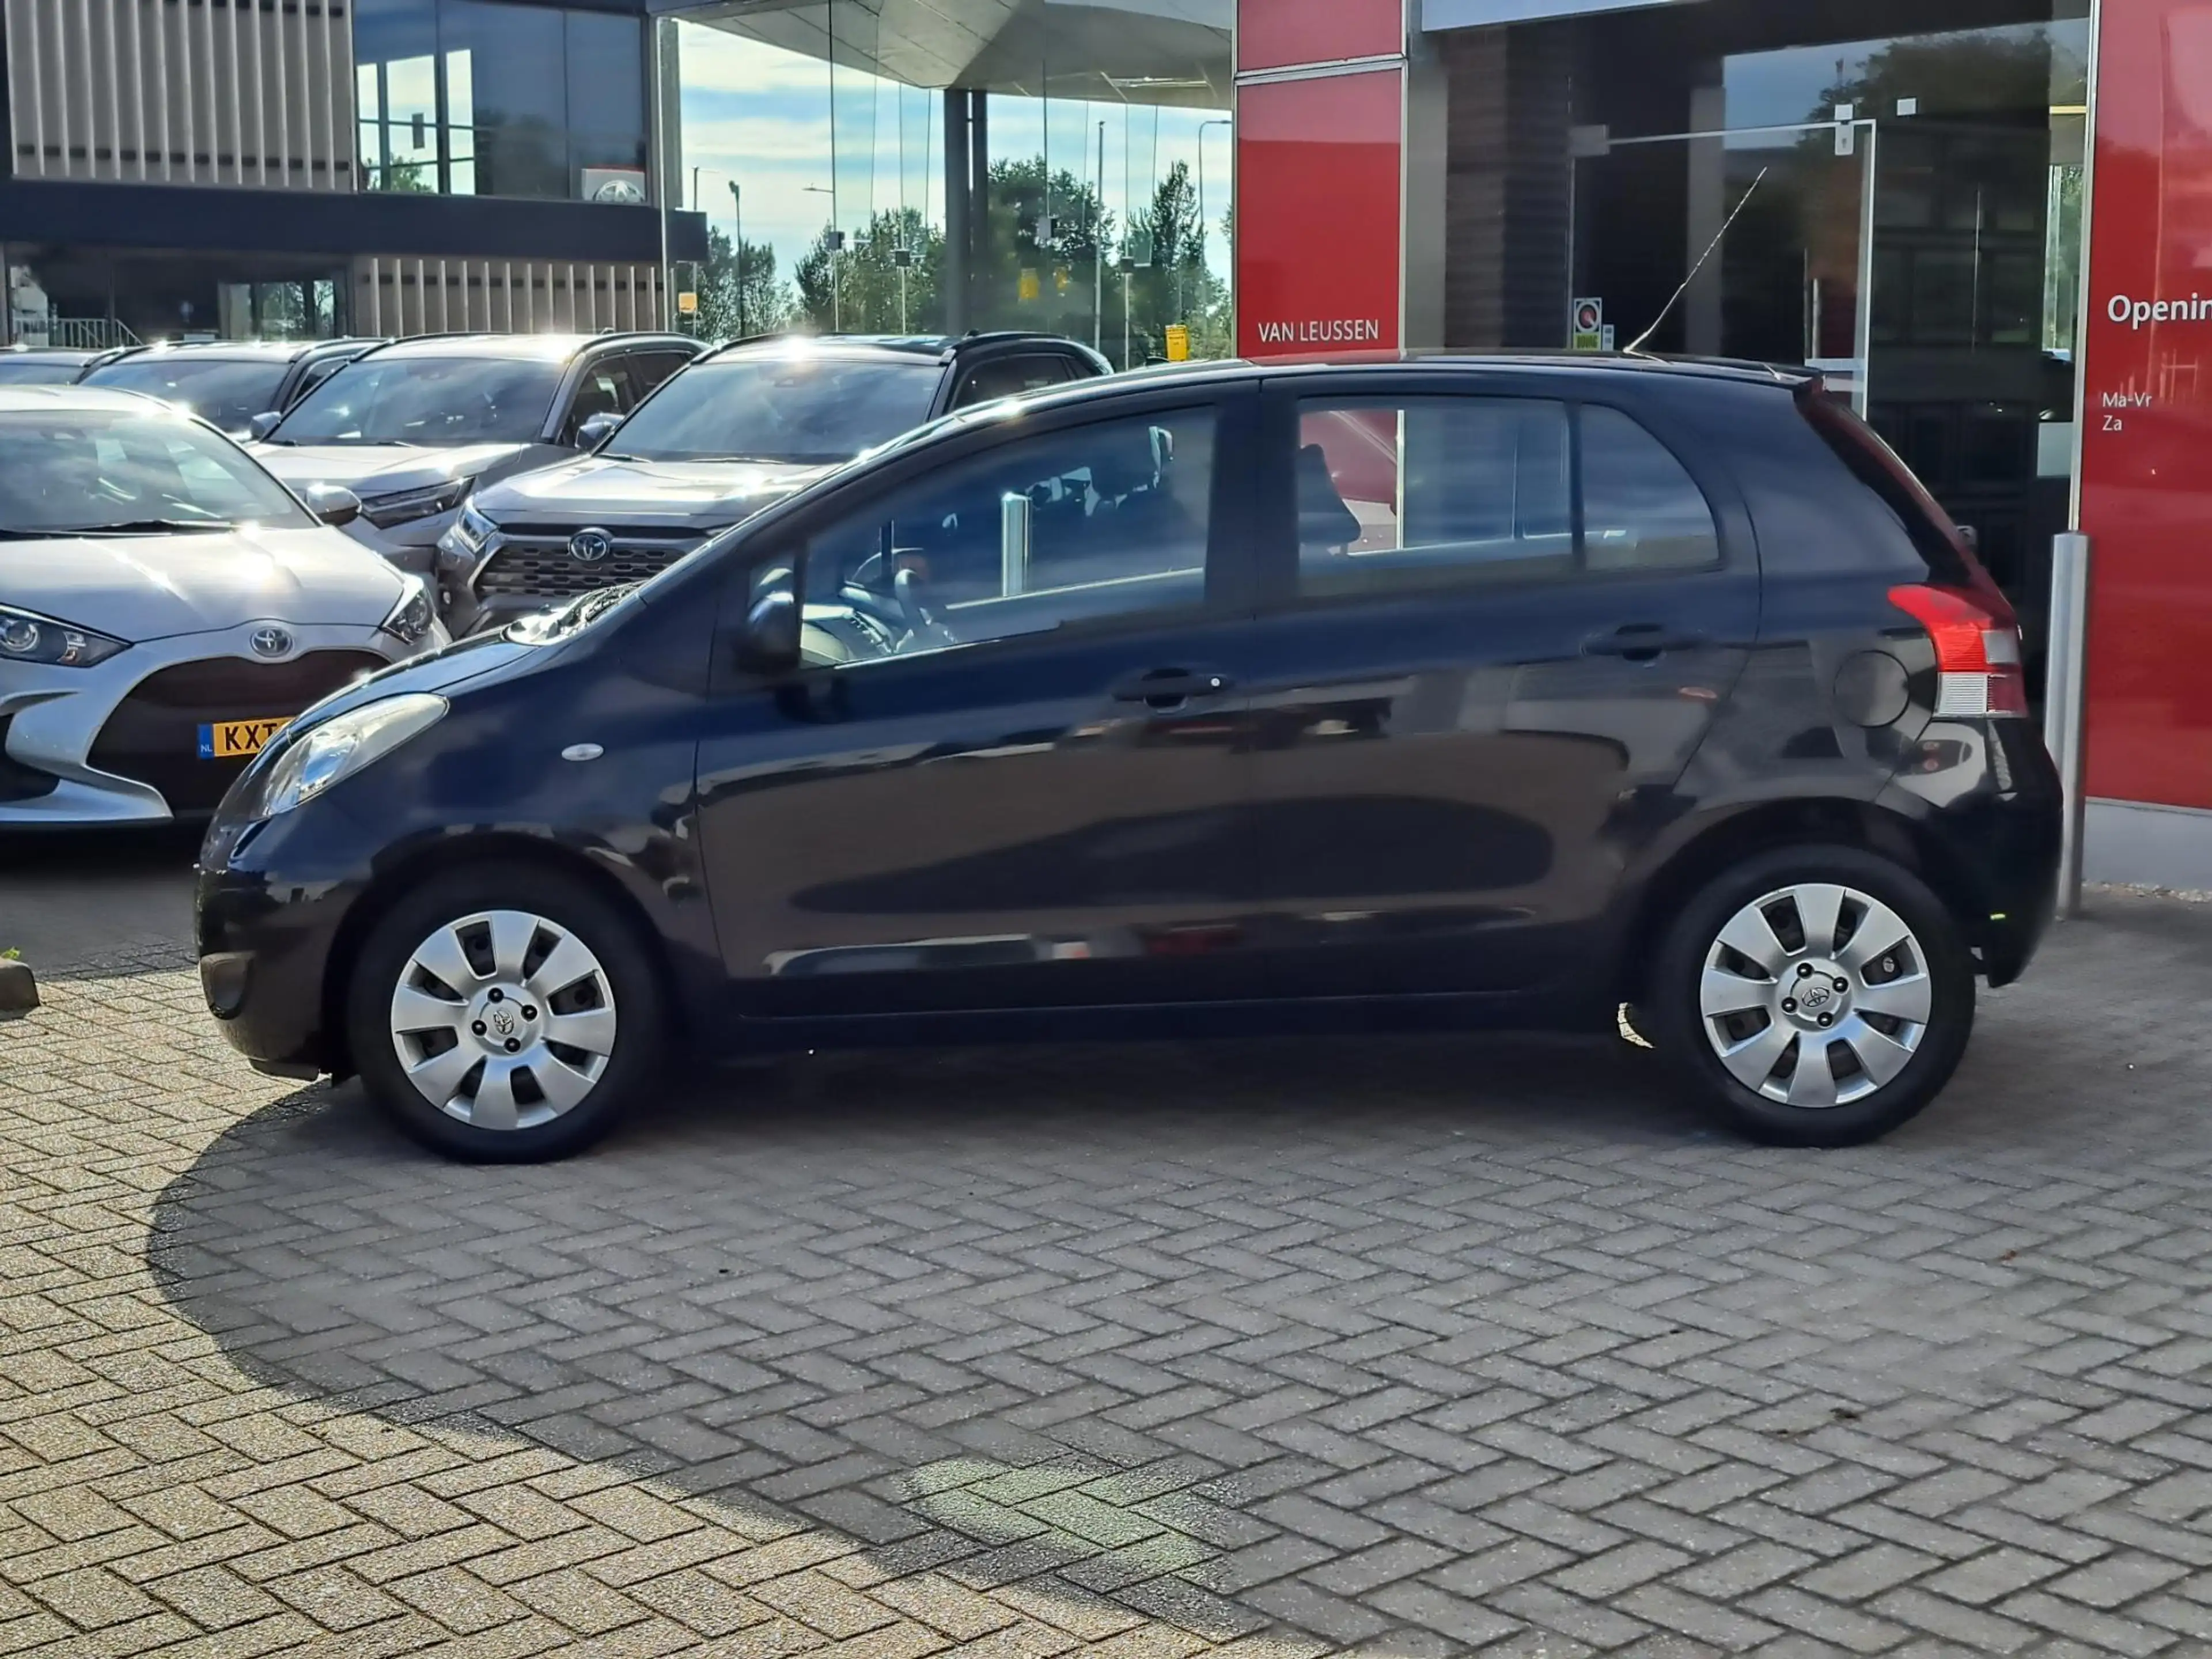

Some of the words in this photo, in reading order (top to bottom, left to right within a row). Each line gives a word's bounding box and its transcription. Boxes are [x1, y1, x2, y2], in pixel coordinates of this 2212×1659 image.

[2107, 293, 2212, 330] Openin
[1258, 322, 1294, 342] VAN
[1300, 319, 1379, 342] LEUSSEN
[2102, 392, 2152, 408] Ma-Vr
[2102, 414, 2123, 431] Za
[200, 744, 213, 752] NL
